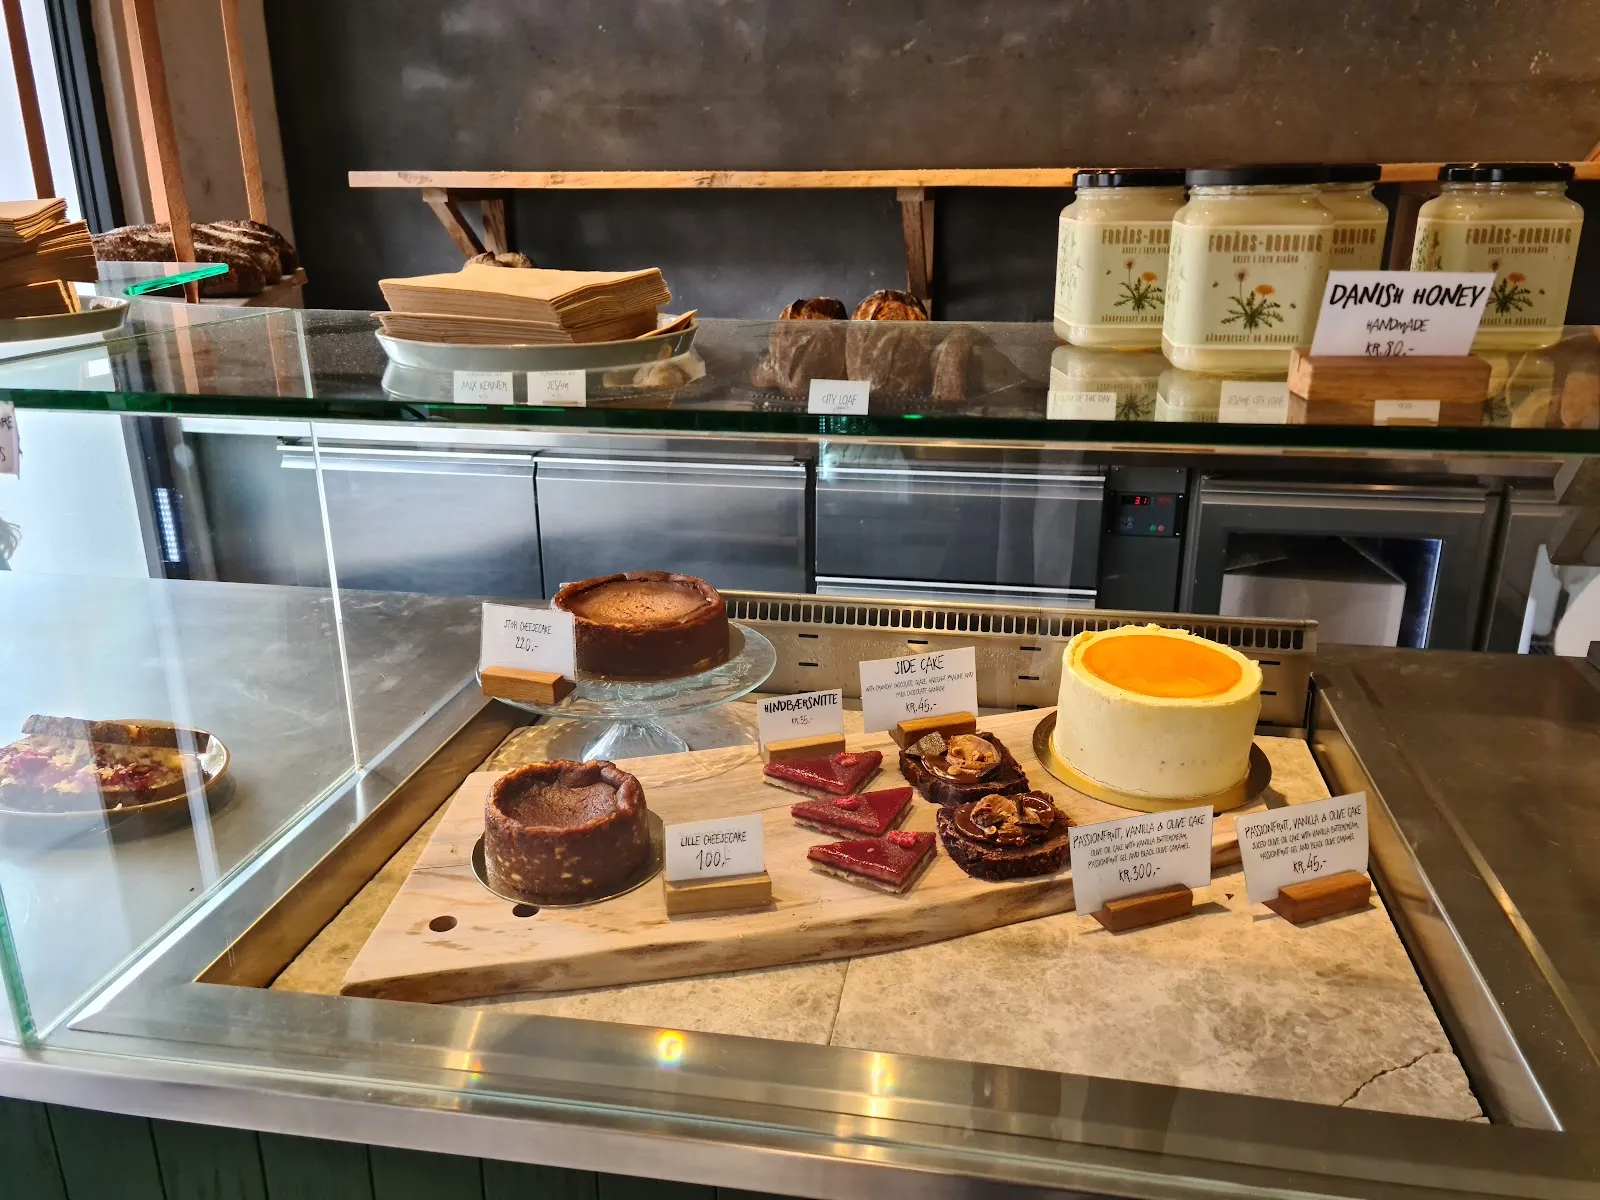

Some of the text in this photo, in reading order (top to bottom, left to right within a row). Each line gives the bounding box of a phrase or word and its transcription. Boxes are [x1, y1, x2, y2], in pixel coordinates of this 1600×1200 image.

[1329, 282, 1486, 309] DANISH HONEY
[821, 393, 859, 406] CITY LOAF
[895, 654, 945, 675] SIDE CAKE
[764, 693, 838, 714] HINDBÆRSNITTE
[1126, 822, 1155, 839] VANILLA
[1167, 817, 1186, 830] OLIVE
[1189, 815, 1206, 828] CAKE
[1293, 814, 1319, 830] VANILLA
[1330, 809, 1346, 821] OLIVE
[1348, 805, 1362, 818] CAKE
[680, 831, 747, 847] LILLE CHEESECAKE
[1300, 843, 1310, 852] AND
[1129, 851, 1140, 860] AND
